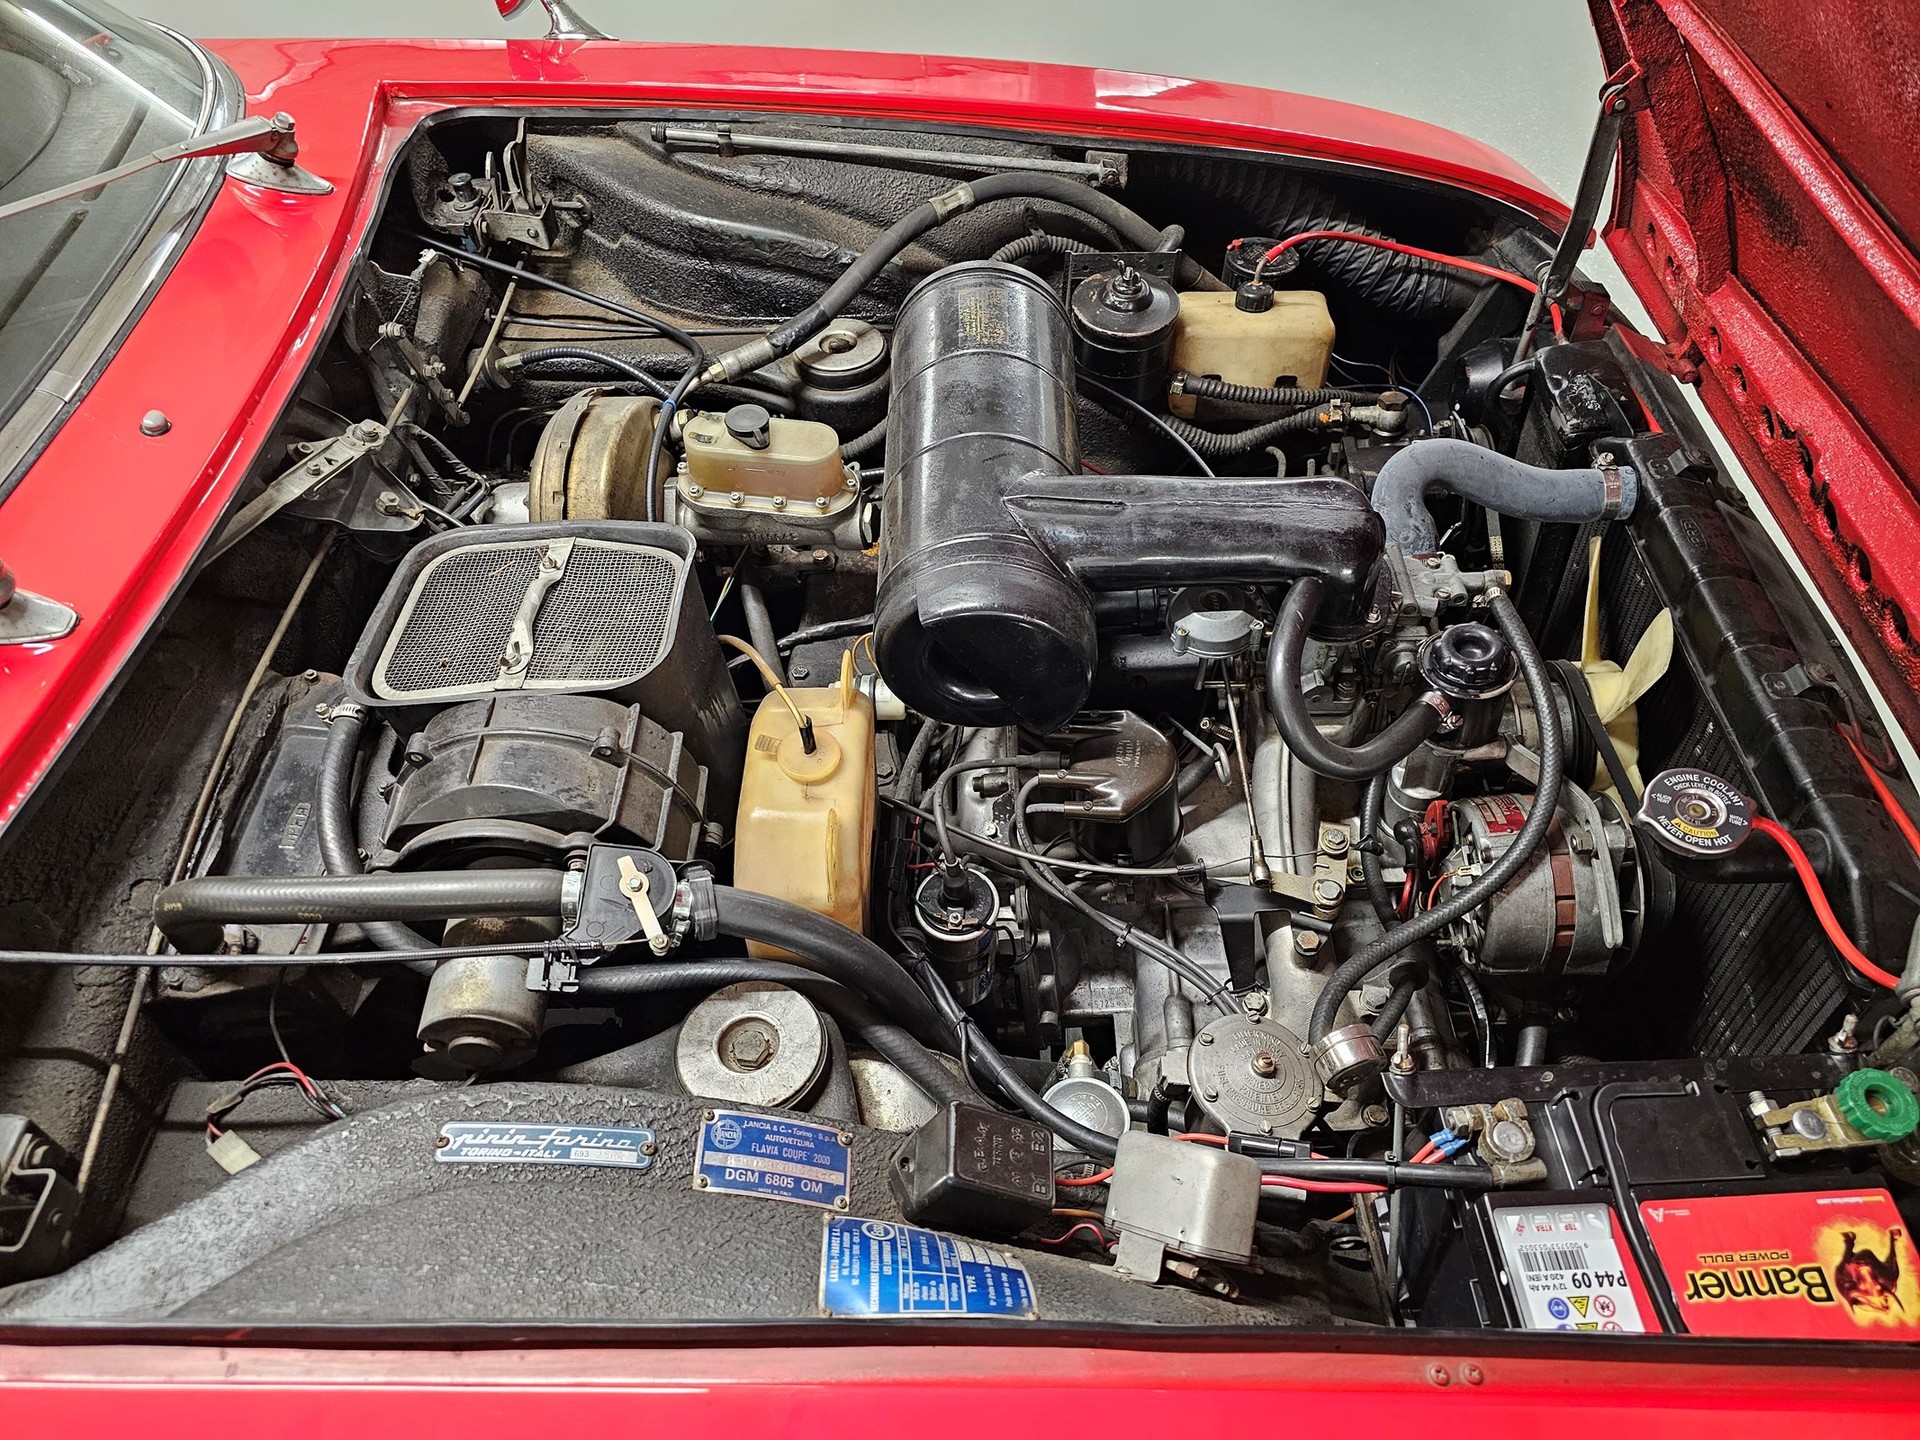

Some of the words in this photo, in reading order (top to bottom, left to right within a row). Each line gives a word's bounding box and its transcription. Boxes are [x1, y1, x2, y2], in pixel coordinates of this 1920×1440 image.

[1664, 774, 1700, 786] ENGINE
[1703, 777, 1744, 807] COOLANT
[1673, 783, 1690, 791] CHECK
[1714, 789, 1732, 805] BOTTLE
[1657, 815, 1684, 839] NEVER
[1685, 836, 1712, 846] OPEN
[1713, 834, 1732, 846] HOT
[1728, 818, 1742, 826] TUBE
[1683, 826, 1717, 837] CAUTION
[1226, 1087, 1271, 1115] PRESSURE
[742, 1120, 772, 1132] LANCIA
[793, 1128, 812, 1138] Torino
[1011, 1126, 1024, 1144] A2
[1032, 1129, 1046, 1154] B2
[752, 1142, 778, 1156] FLAVIA
[814, 1154, 830, 1165] 2000
[724, 1168, 758, 1183] DGM
[765, 1173, 794, 1188] 6805
[801, 1181, 823, 1194] OM
[1032, 1171, 1048, 1196] B1
[871, 1224, 885, 1237] Esso
[1536, 1224, 1553, 1232] XTRA
[1698, 1255, 1734, 1264] BULL
[1740, 1251, 1790, 1262] POWER
[883, 1265, 892, 1275] LES
[1526, 1274, 1542, 1282] (EN)
[1550, 1273, 1564, 1281] 420
[1594, 1270, 1628, 1288] P44
[966, 1275, 977, 1292] TYPE
[1528, 1284, 1540, 1292] Ah
[1571, 1271, 1592, 1289] 09
[1686, 1266, 1836, 1303] Banner
